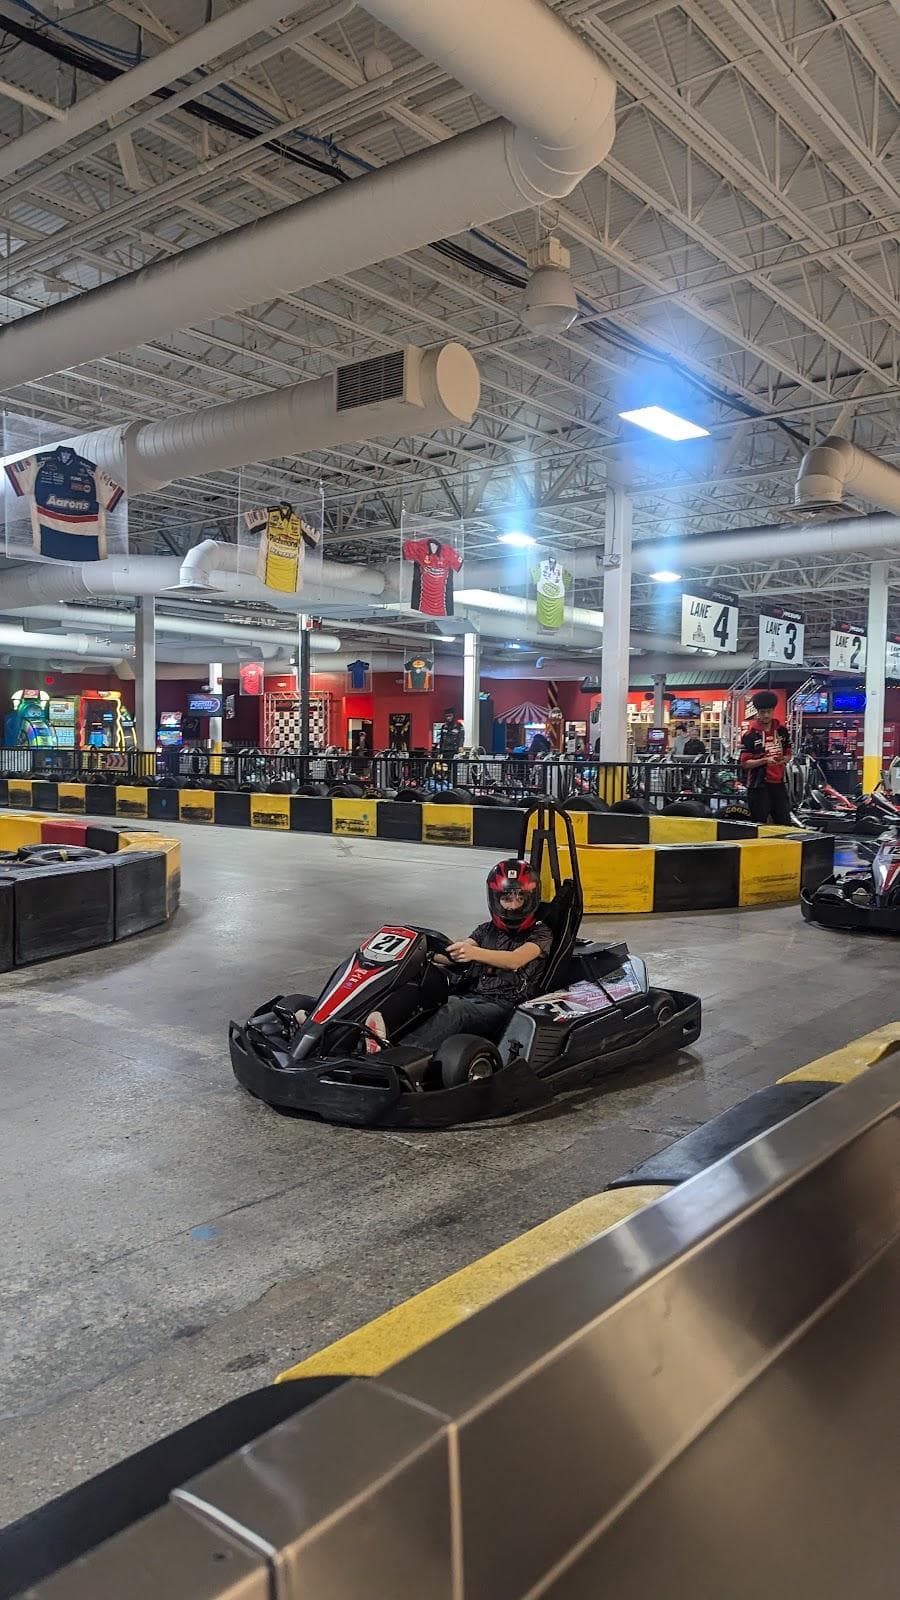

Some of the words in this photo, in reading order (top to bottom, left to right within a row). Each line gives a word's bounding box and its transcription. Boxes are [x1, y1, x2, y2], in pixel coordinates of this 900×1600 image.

[690, 601, 712, 619] LANE
[713, 606, 730, 647] 4
[765, 621, 783, 636] LANE
[784, 622, 798, 660] 3
[835, 634, 850, 648] LANE
[850, 636, 861, 669] 2
[371, 935, 406, 953] 27
